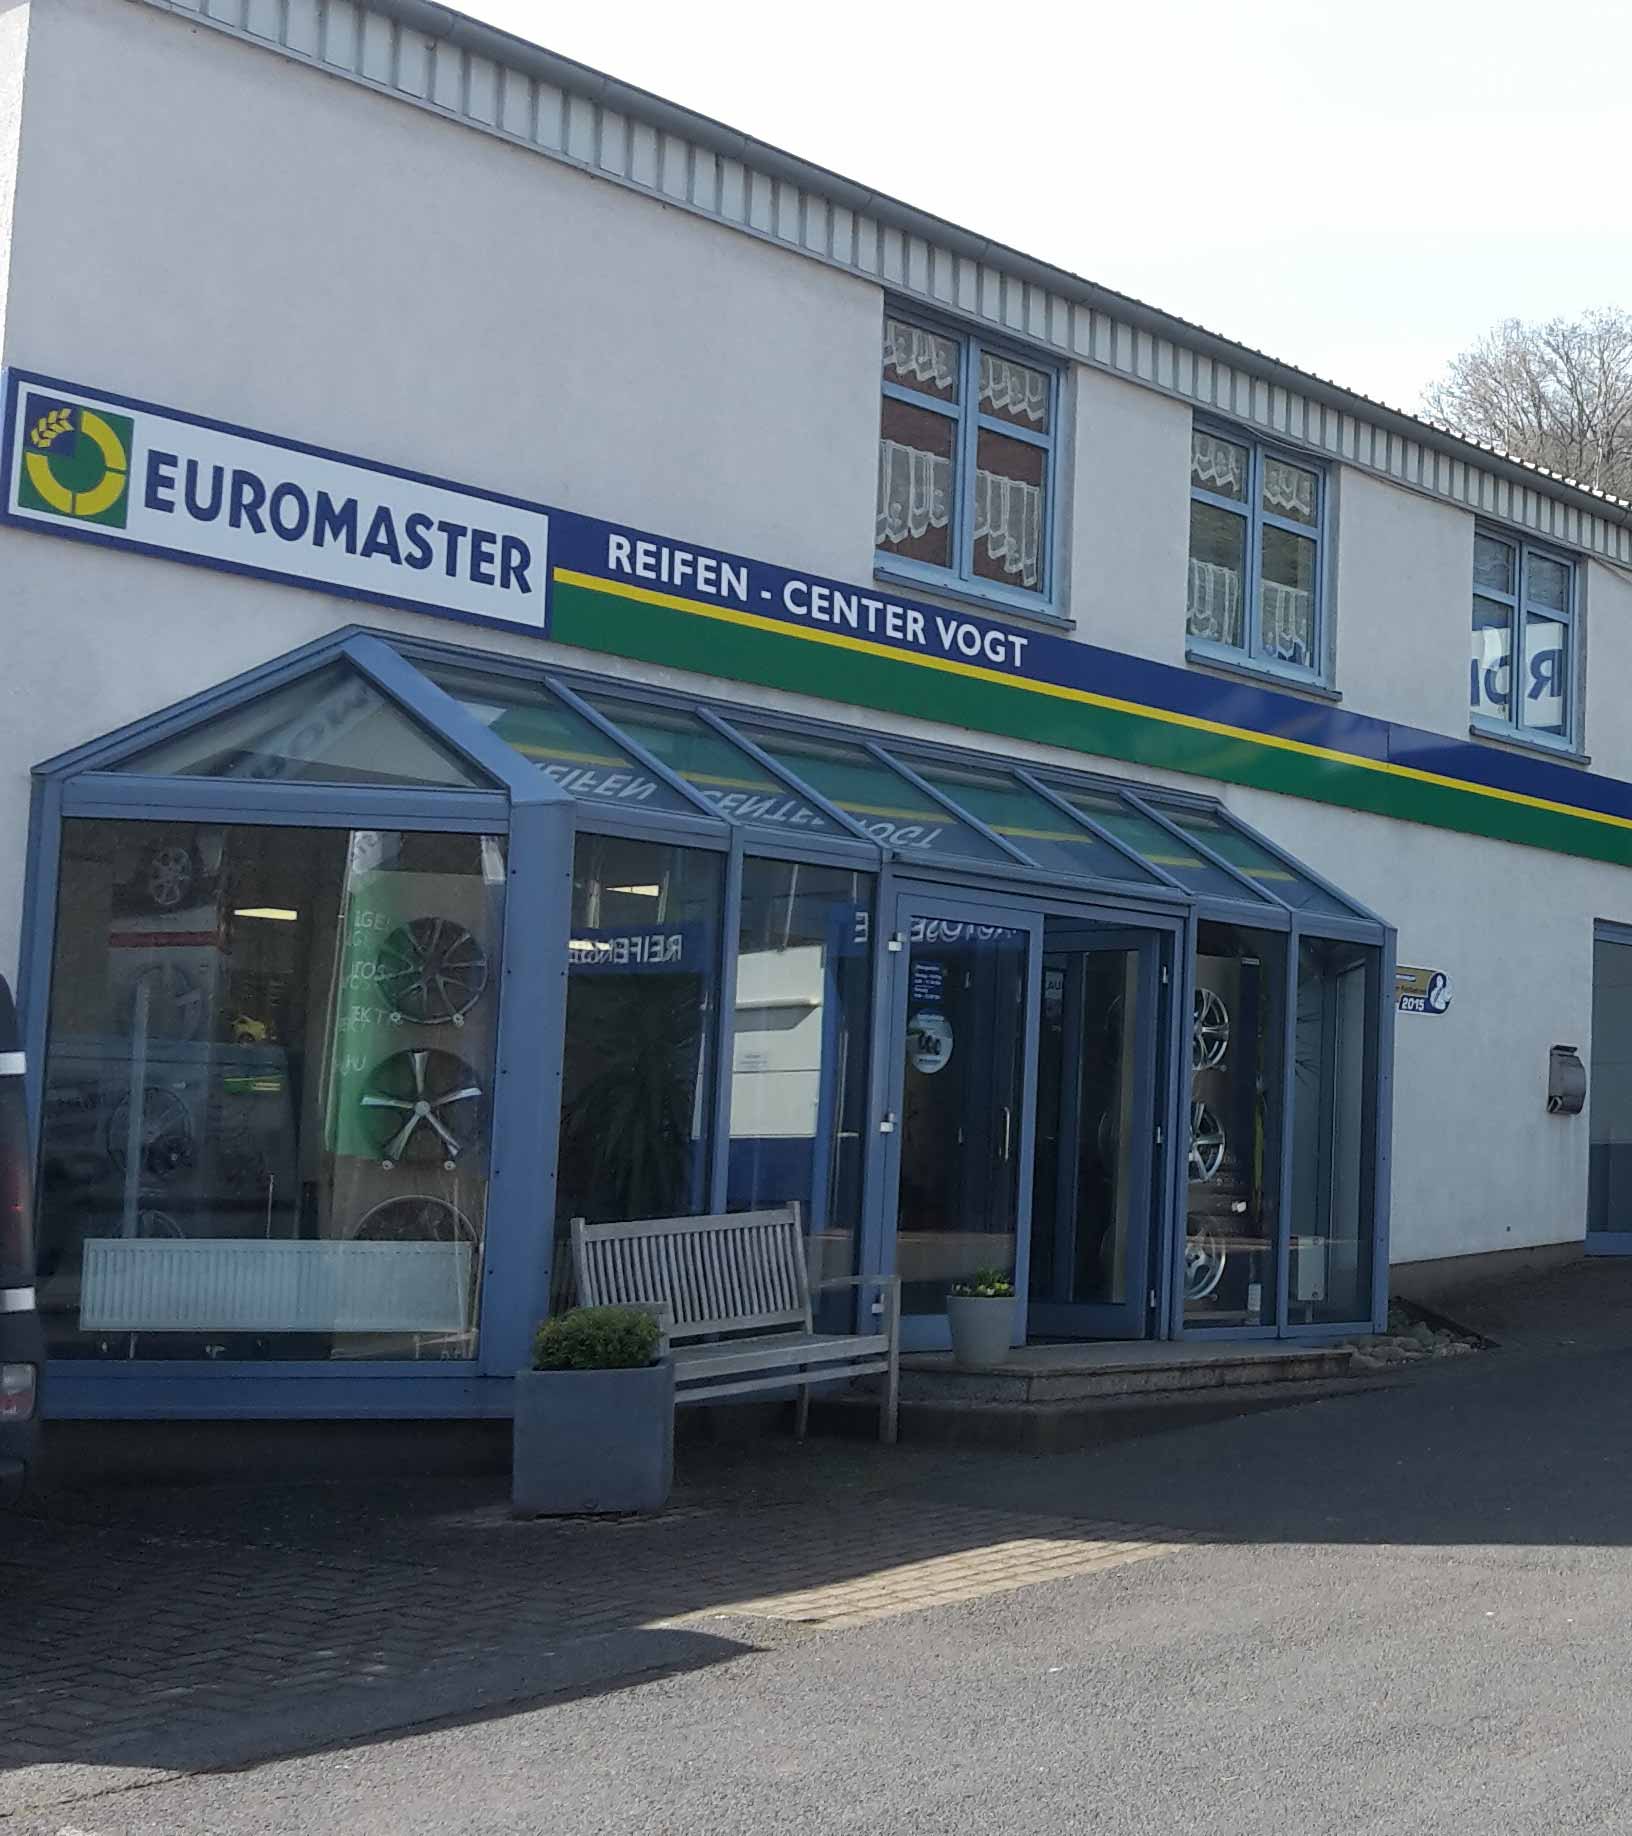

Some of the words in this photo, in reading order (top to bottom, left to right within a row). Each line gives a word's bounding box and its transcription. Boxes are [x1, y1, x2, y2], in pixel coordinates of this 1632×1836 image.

[144, 448, 533, 594] EUROMASTER
[607, 533, 749, 602] REIFEN
[783, 580, 927, 645] CENTER
[935, 616, 1029, 668] VOGT
[1402, 997, 1425, 1012] 2015
